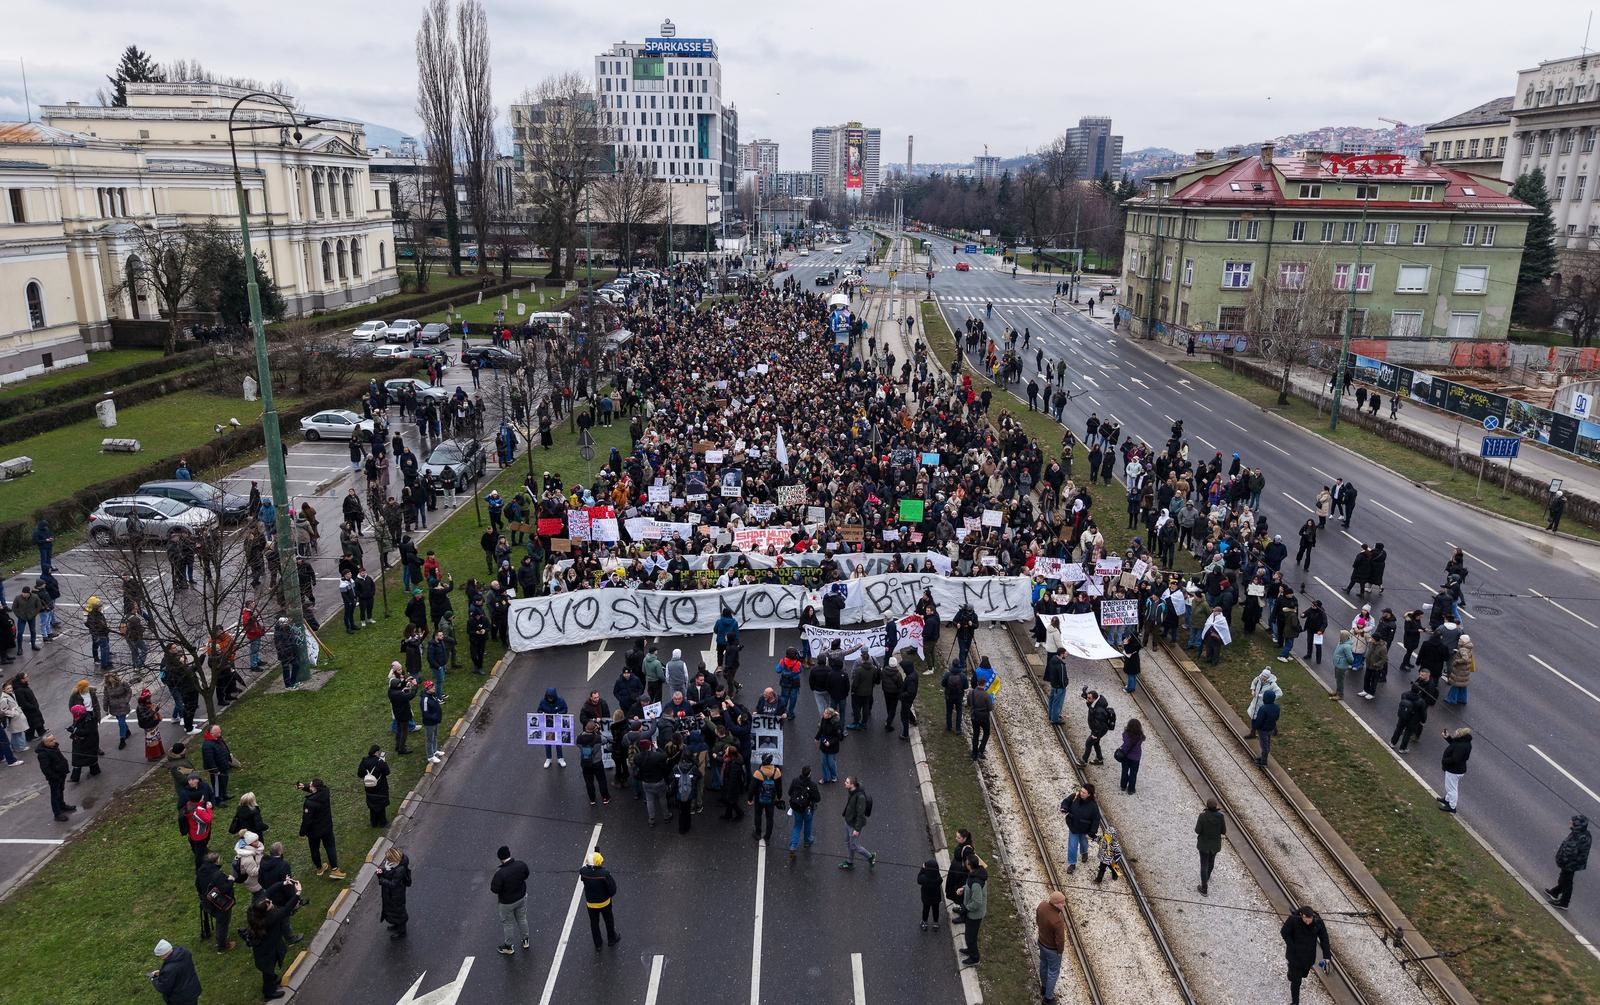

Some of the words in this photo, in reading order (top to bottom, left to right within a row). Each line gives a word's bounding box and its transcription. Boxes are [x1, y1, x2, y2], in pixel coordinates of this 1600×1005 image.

[645, 41, 701, 52] SPARKASSE
[736, 530, 766, 541] SADA
[515, 597, 600, 639] OVO
[610, 595, 698, 632] SMO
[962, 579, 1018, 614] MI
